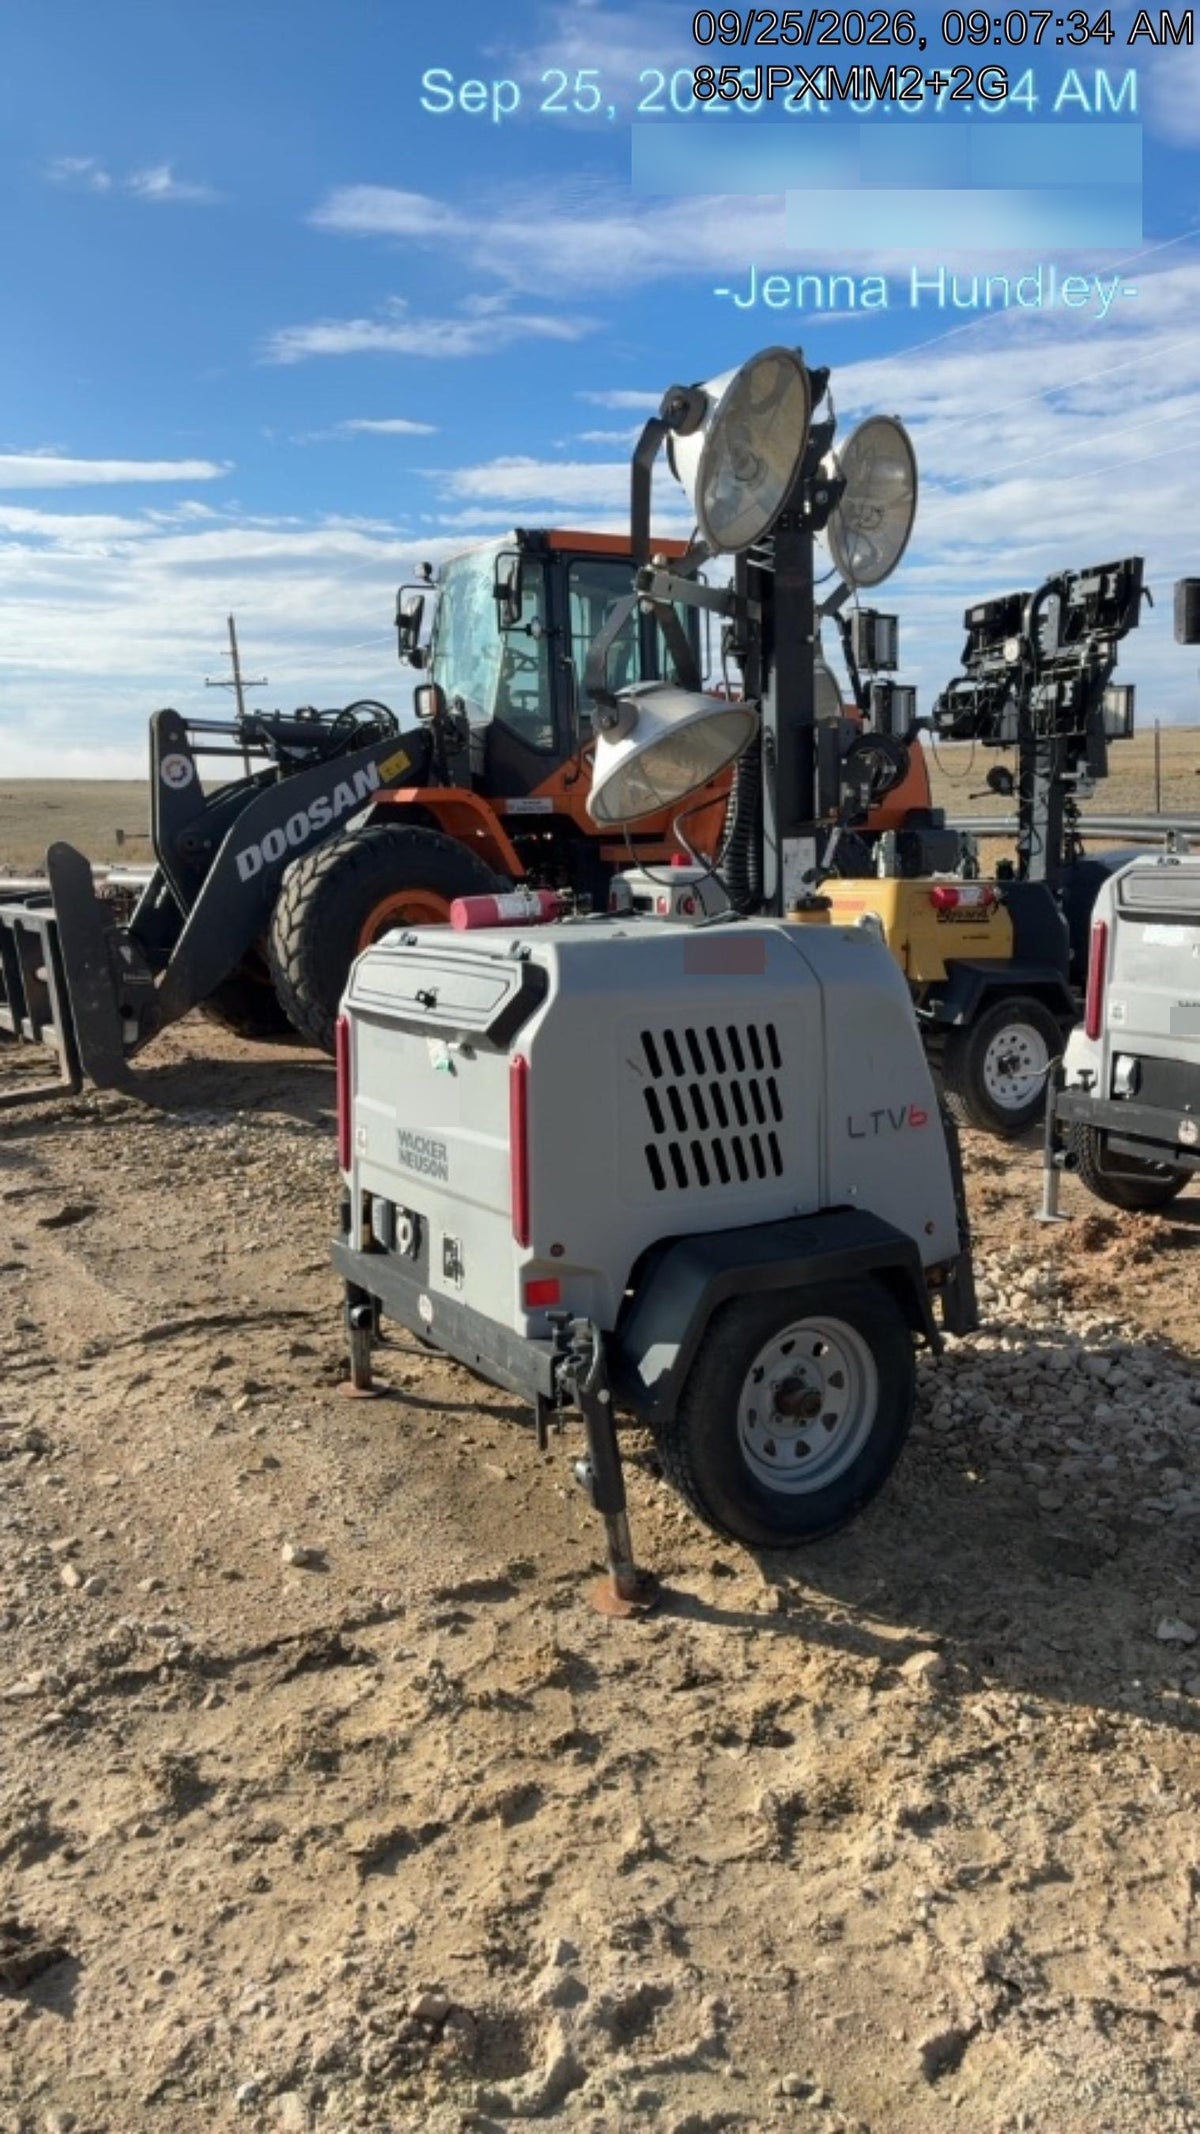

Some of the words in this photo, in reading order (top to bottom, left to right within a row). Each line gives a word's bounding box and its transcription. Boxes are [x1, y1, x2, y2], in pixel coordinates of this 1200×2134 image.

[234, 760, 381, 883] DOOSAN
[847, 1104, 929, 1138] LTV6
[397, 1127, 447, 1162] WACKER
[399, 1147, 448, 1182] NEUSON
